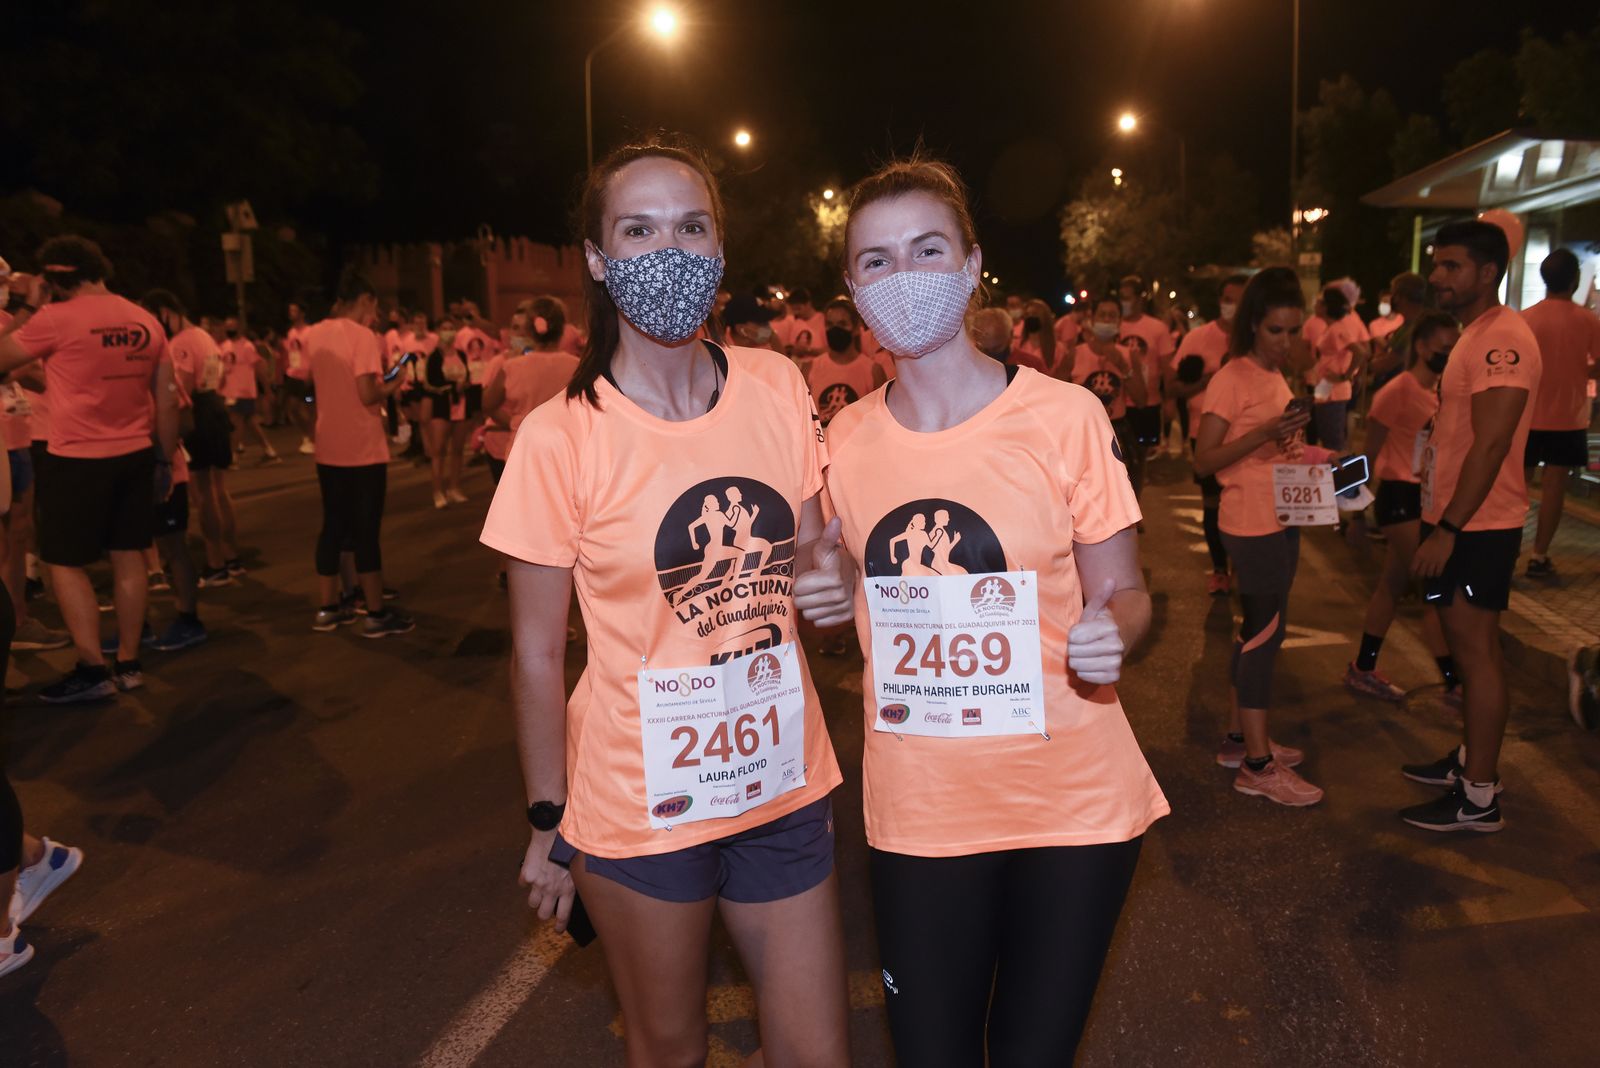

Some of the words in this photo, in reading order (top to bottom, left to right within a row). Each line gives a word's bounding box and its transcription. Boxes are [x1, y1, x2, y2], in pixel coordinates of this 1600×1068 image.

[1282, 486, 1323, 503] 6281
[676, 603, 704, 624] LA
[697, 617, 716, 638] del
[716, 600, 788, 627] Guadalquivir
[957, 621, 1006, 629] GUADALQUIVIR
[893, 632, 1012, 678] 2469
[883, 683, 922, 696] PHILIPPA
[924, 686, 969, 697] HARRIET
[972, 683, 1030, 696] BURGHAM
[667, 714, 697, 723] CARRERA
[697, 710, 730, 719] NOCTURNA
[729, 705, 739, 714] DEL
[739, 693, 777, 710] GUADALQUIVIR
[788, 686, 801, 695] 2021
[882, 708, 905, 721] KH7
[671, 704, 780, 769] 2461
[699, 770, 737, 783] LAURA
[737, 758, 767, 777] FLOYD
[783, 766, 796, 777] ABC
[656, 800, 687, 815] KH7
